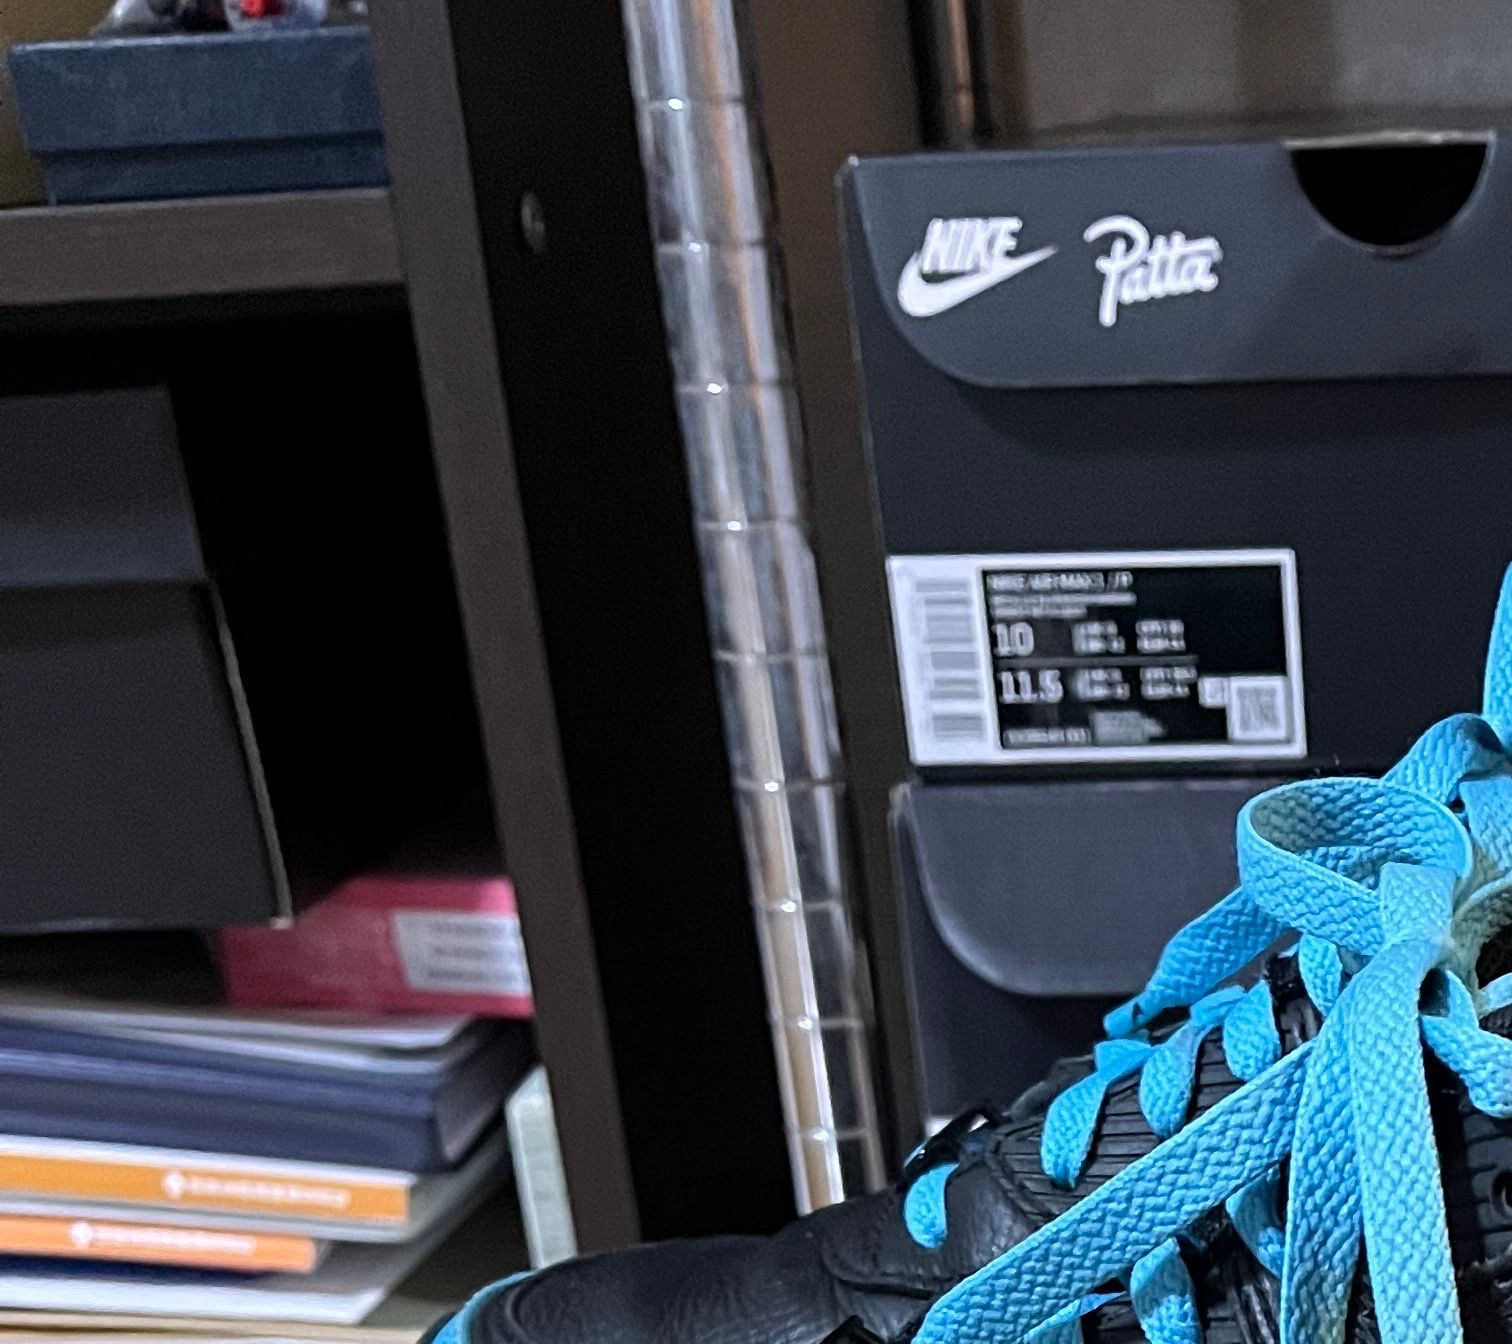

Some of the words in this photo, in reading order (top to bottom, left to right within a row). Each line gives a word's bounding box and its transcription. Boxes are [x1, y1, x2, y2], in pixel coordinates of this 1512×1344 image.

[921, 217, 1022, 274] NIKE
[1084, 214, 1223, 327] Patta
[992, 621, 1035, 657] 10
[998, 668, 1064, 704] 11.5
